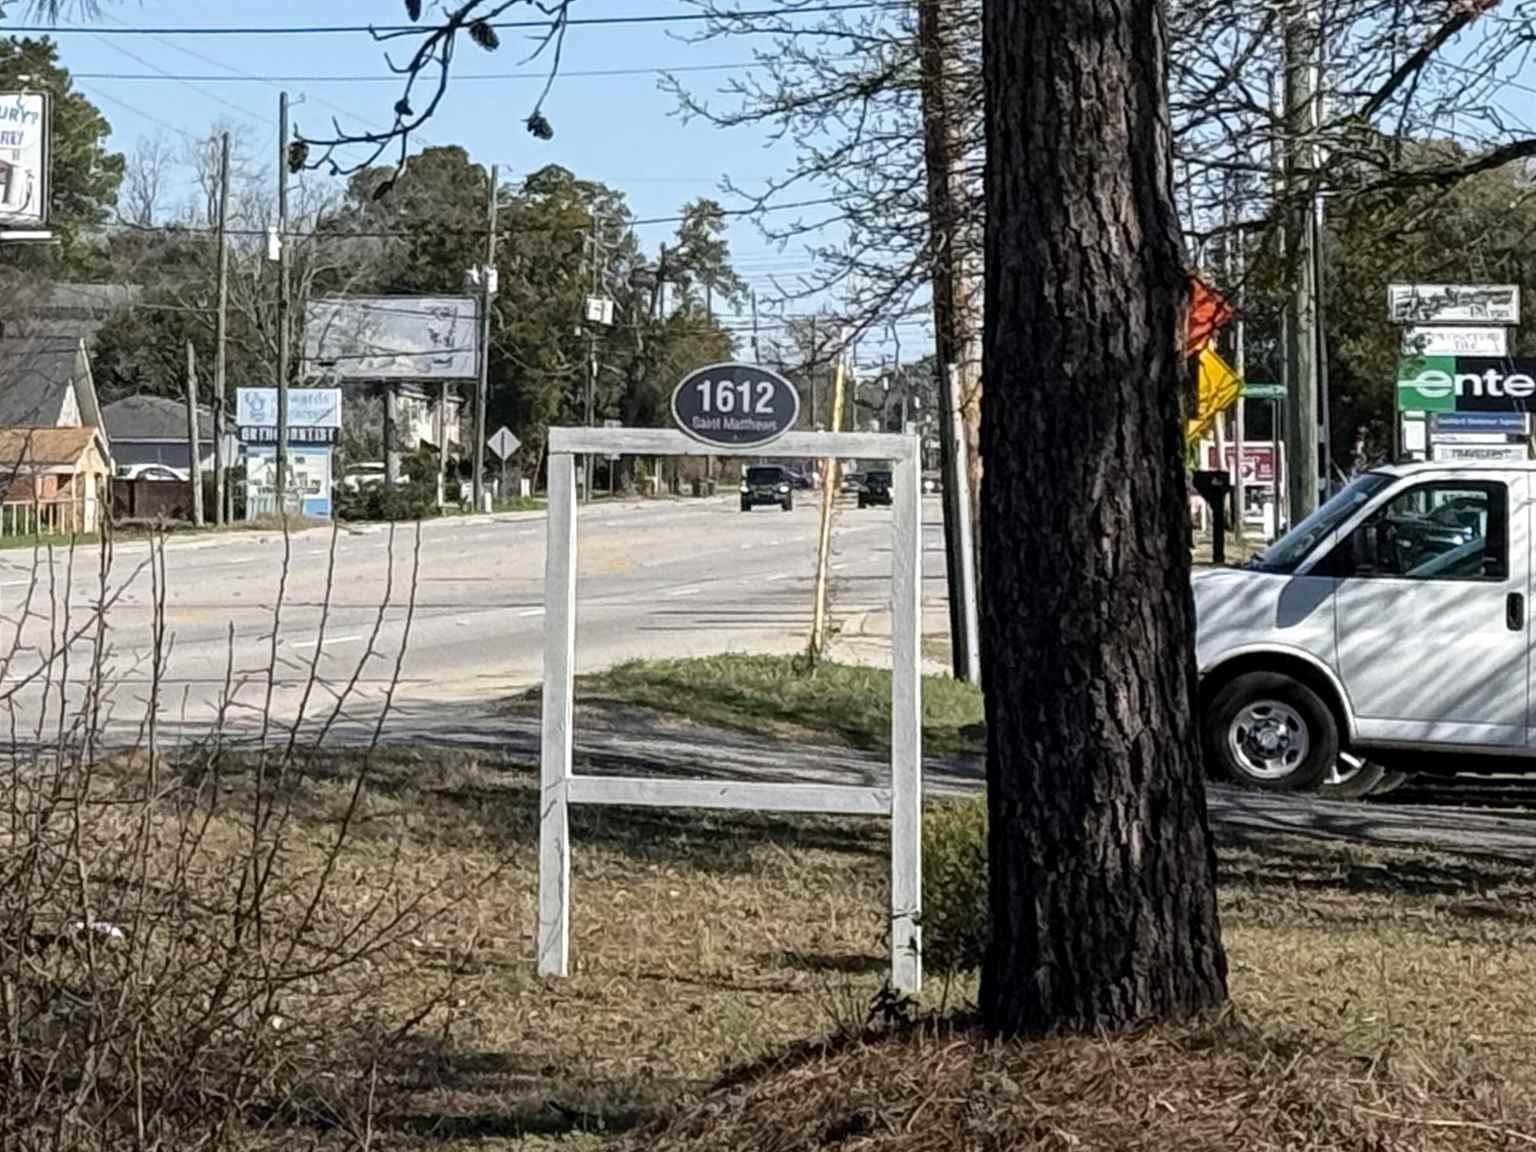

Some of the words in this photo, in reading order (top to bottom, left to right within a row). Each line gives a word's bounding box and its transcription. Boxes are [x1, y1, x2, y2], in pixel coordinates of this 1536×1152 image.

[696, 379, 775, 414] 1612
[1398, 369, 1536, 398] ente
[691, 415, 722, 431] Saint
[723, 416, 778, 432] Matthews
